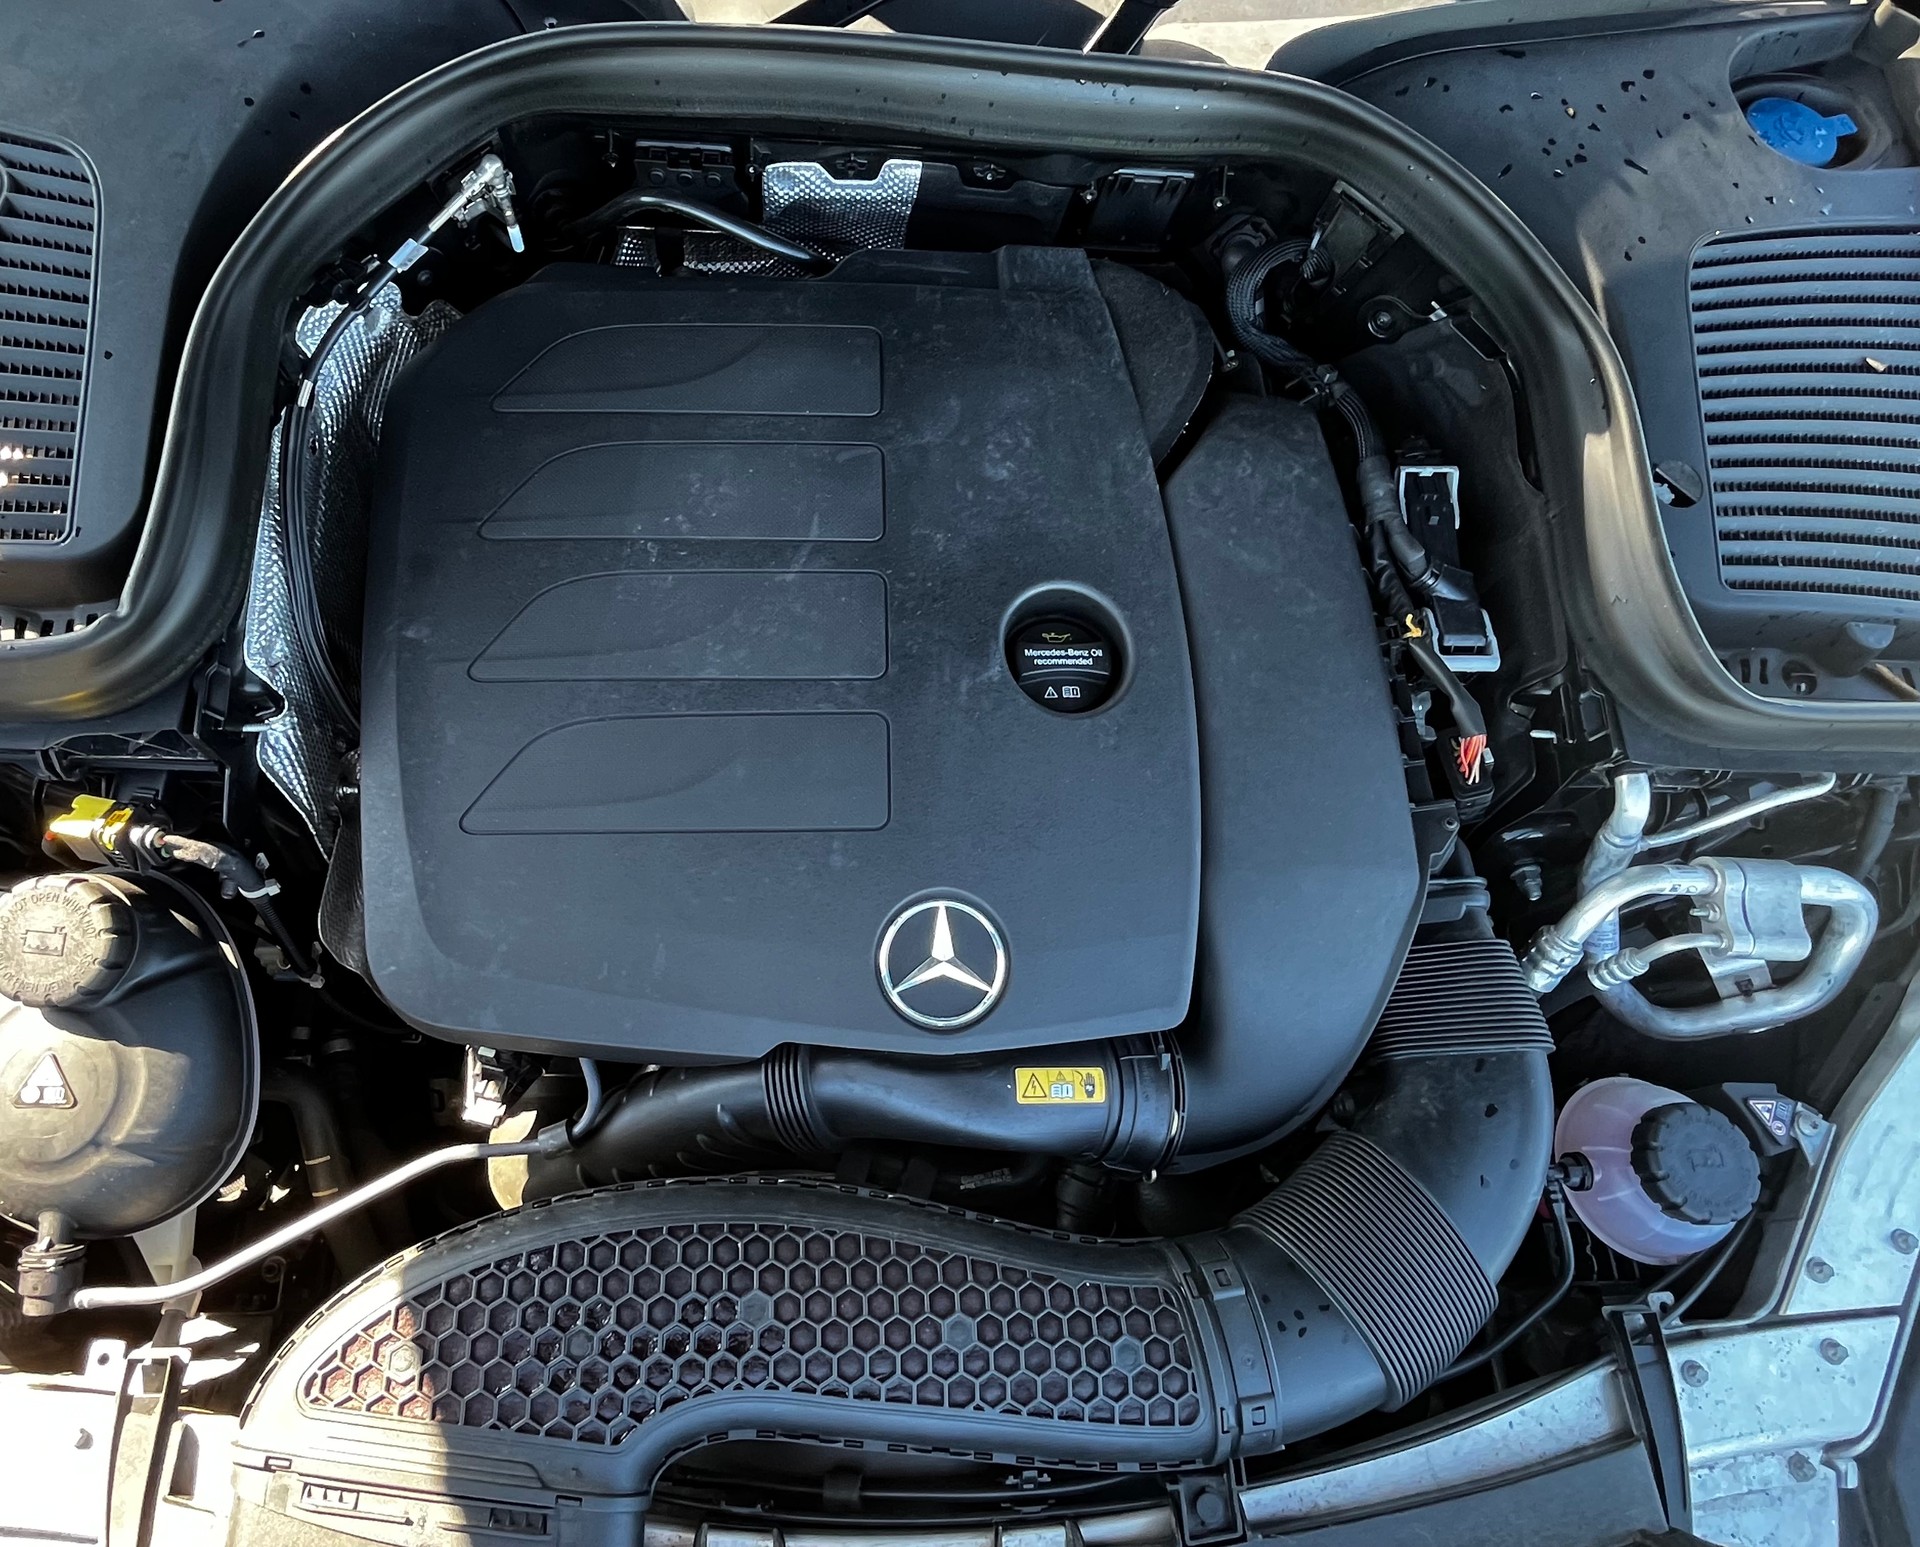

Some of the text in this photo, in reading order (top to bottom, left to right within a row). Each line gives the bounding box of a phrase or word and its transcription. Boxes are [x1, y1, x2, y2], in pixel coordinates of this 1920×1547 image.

[1024, 648, 1103, 657] Mercedes-Benz Oil
[1033, 657, 1093, 665] recommended
[7, 897, 27, 917] NOT
[31, 892, 60, 904] OPEN
[62, 895, 91, 919] WHEN
[83, 919, 98, 939] HOT
